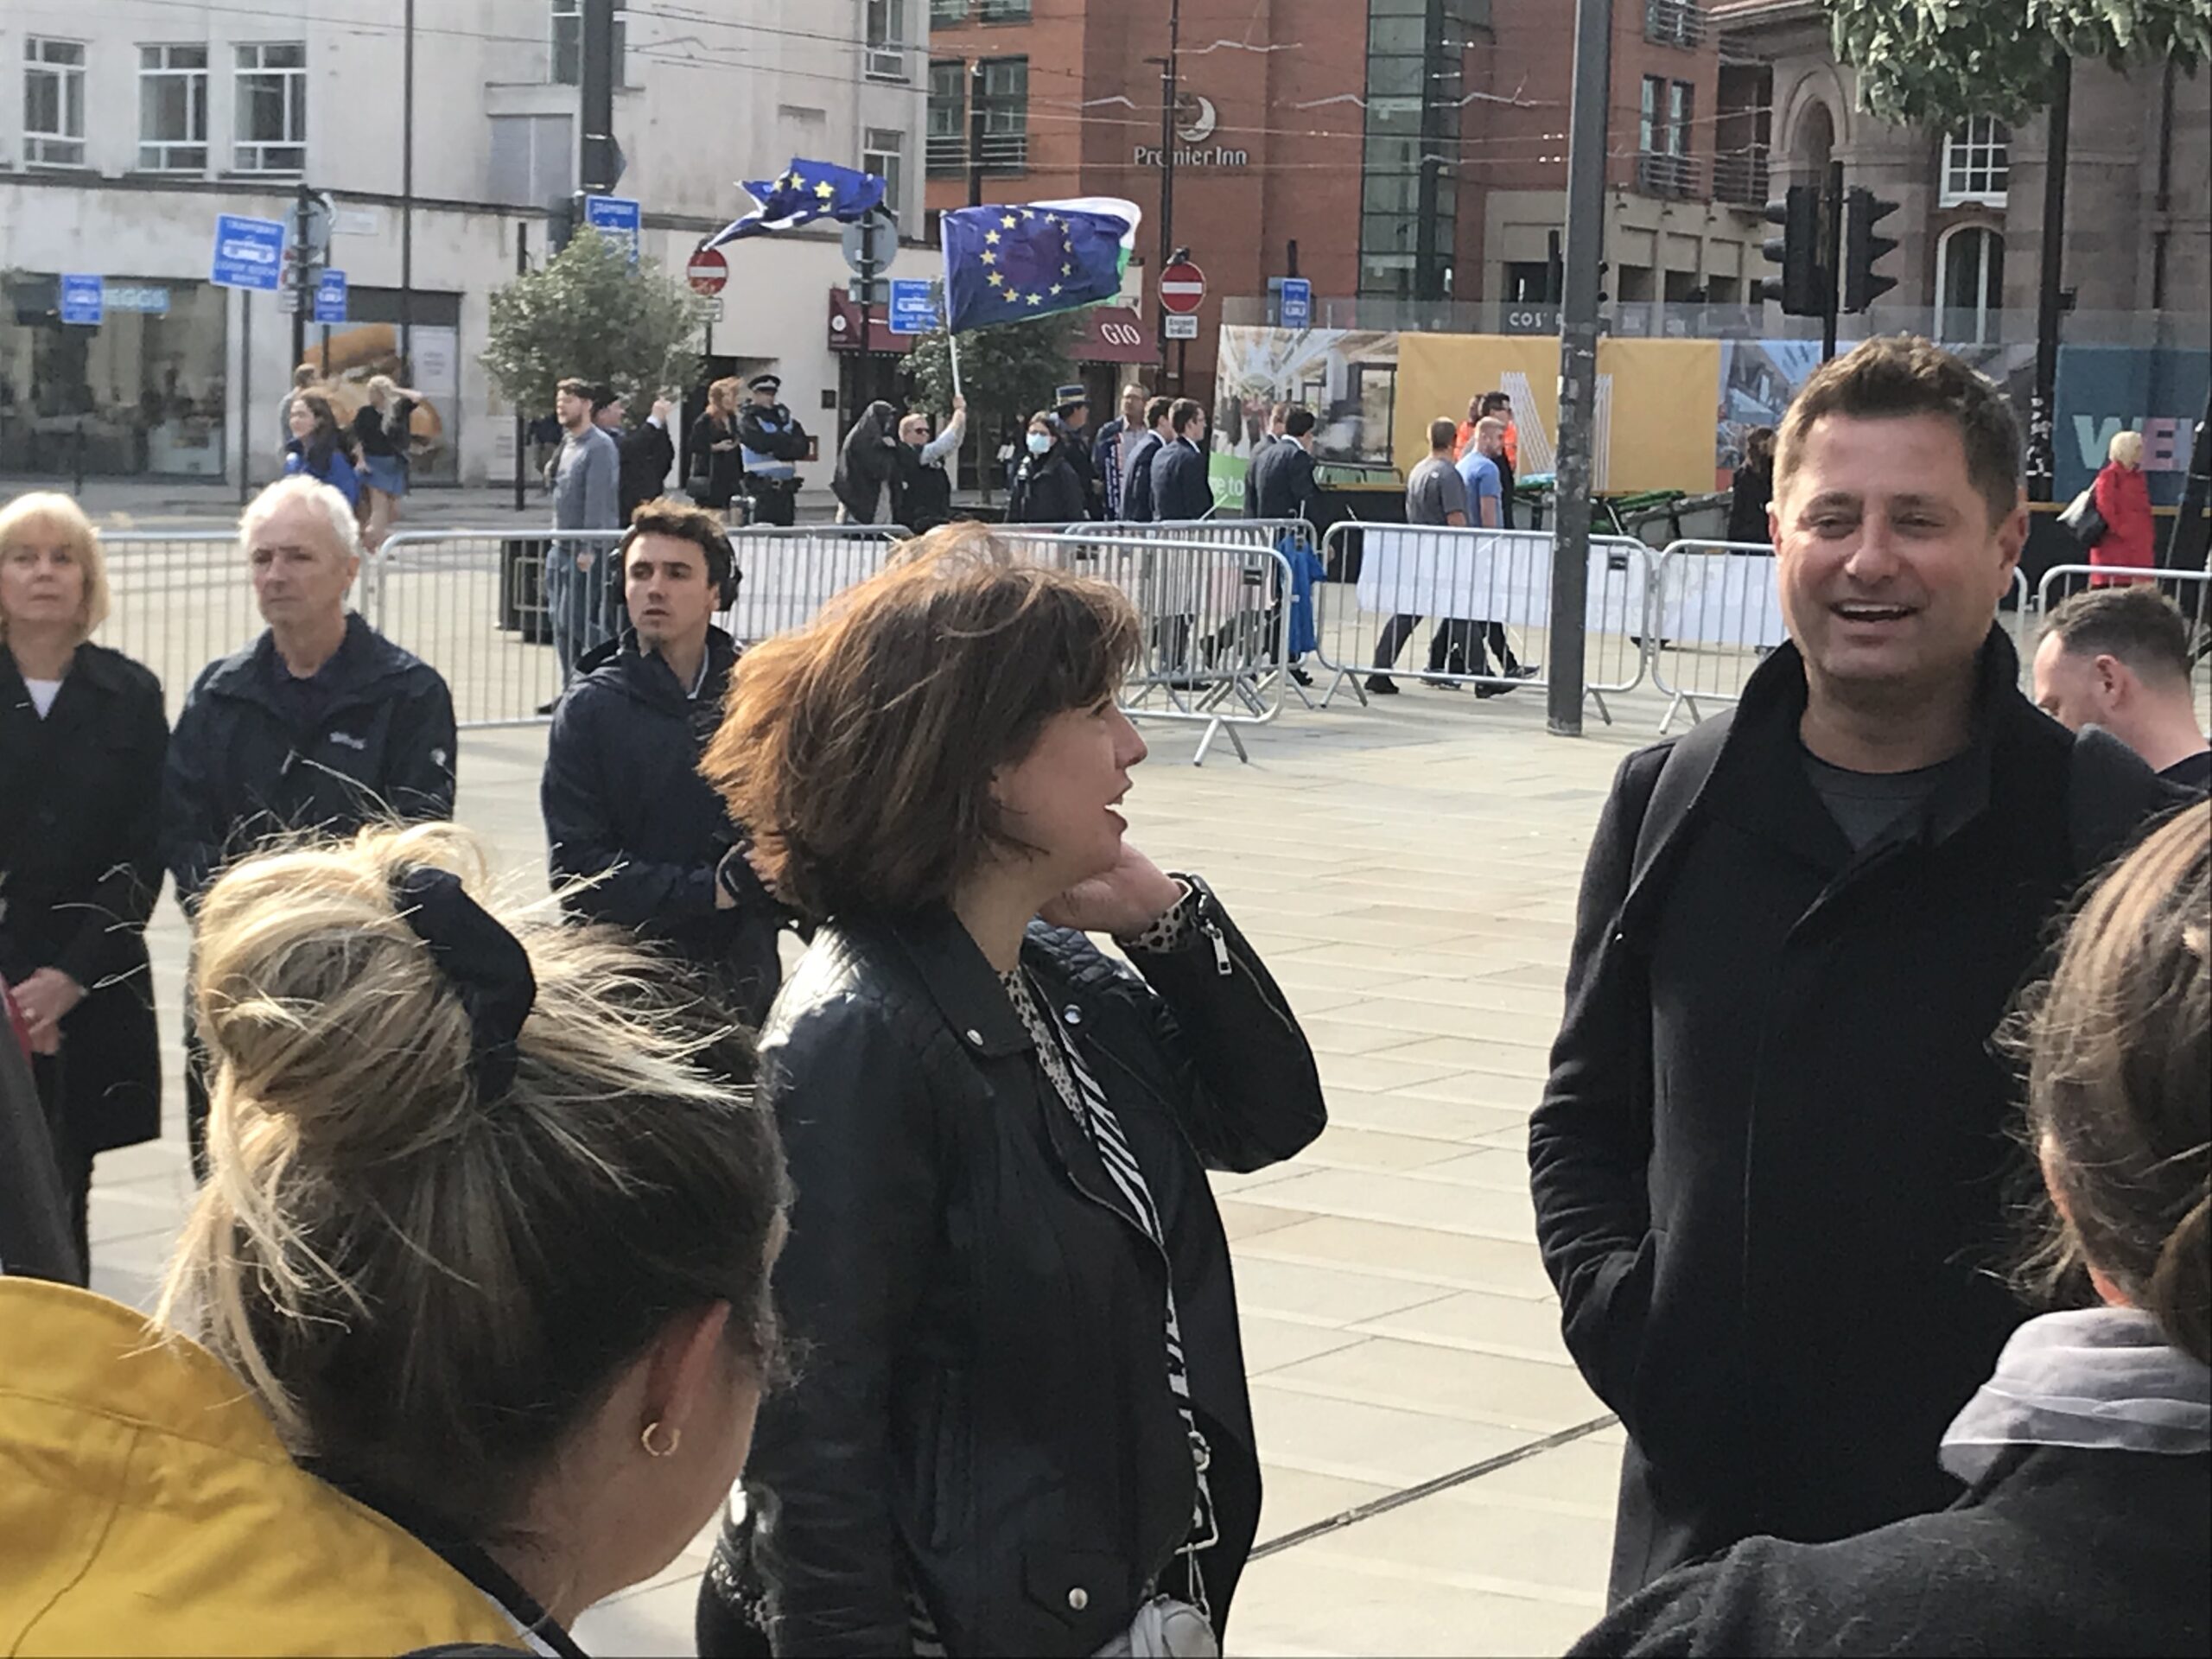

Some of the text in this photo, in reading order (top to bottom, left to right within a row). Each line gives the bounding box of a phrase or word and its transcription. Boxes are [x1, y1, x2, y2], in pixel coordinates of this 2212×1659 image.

[1133, 145, 1248, 167] Premier Inn
[1101, 322, 1141, 345] GIO
